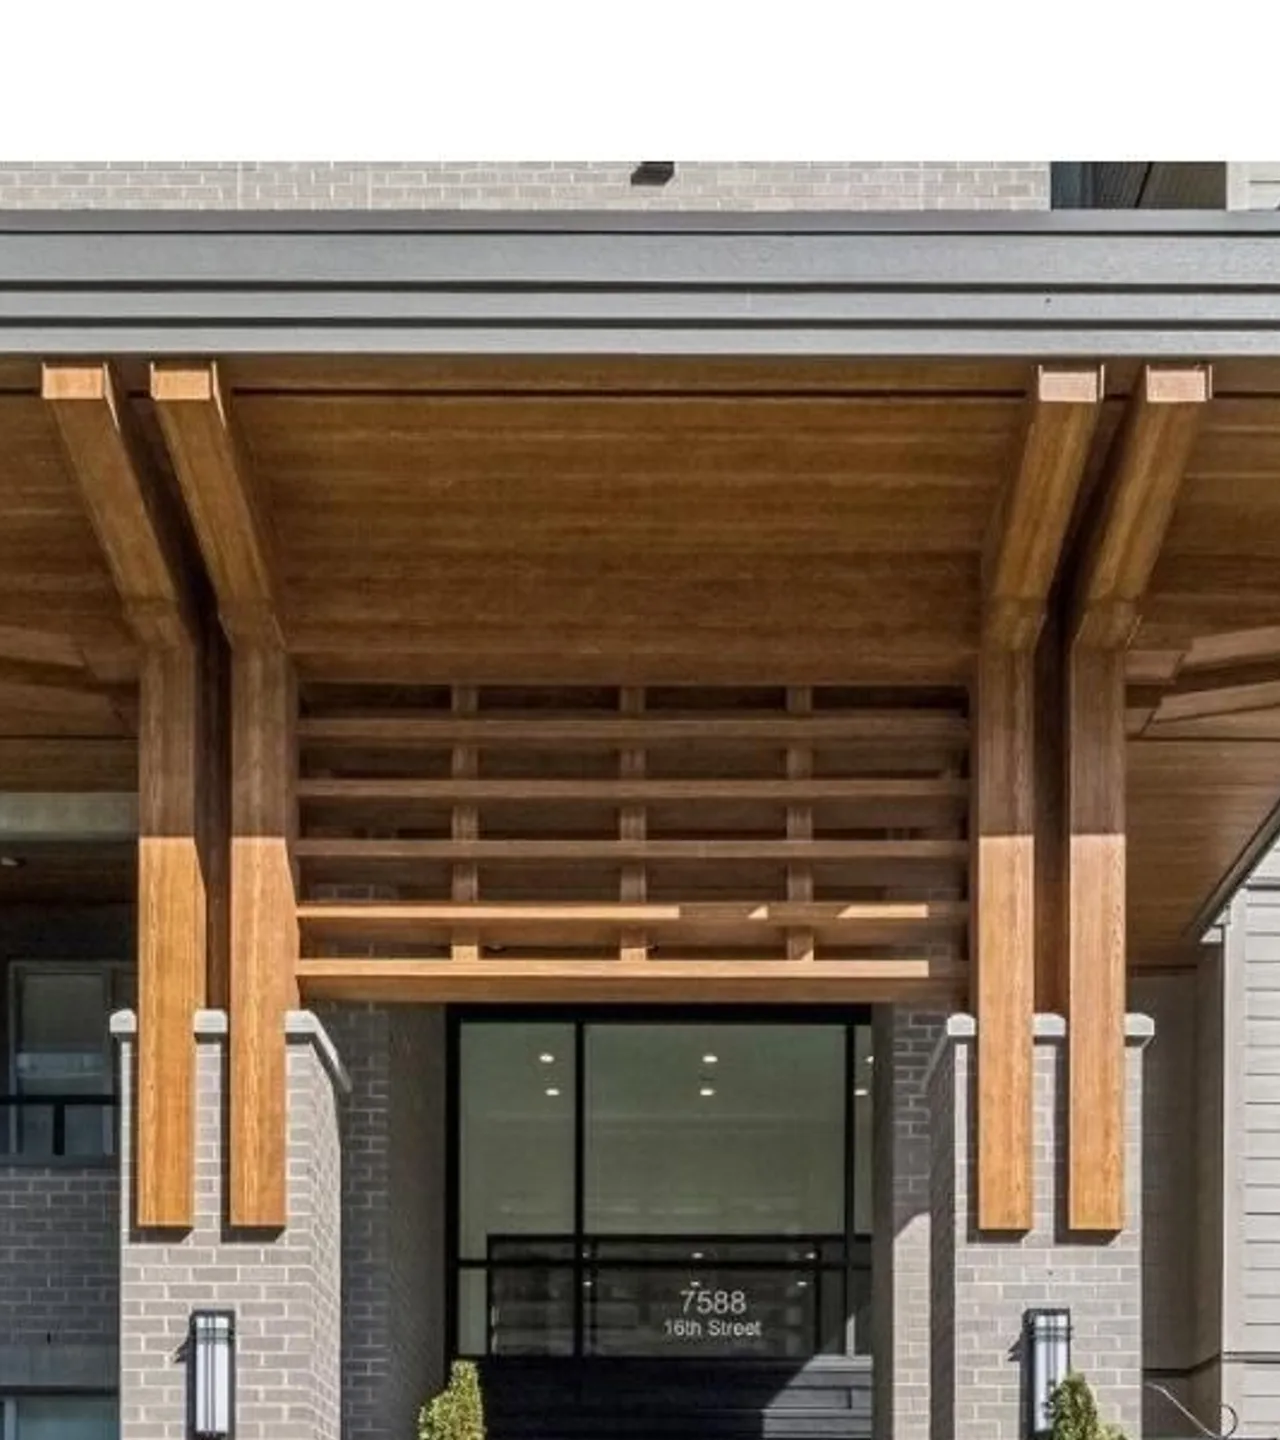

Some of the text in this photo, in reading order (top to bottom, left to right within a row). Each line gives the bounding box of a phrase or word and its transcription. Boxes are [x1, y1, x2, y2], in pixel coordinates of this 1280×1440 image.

[680, 1290, 747, 1315] 7588
[665, 1320, 763, 1337] 16th Street
